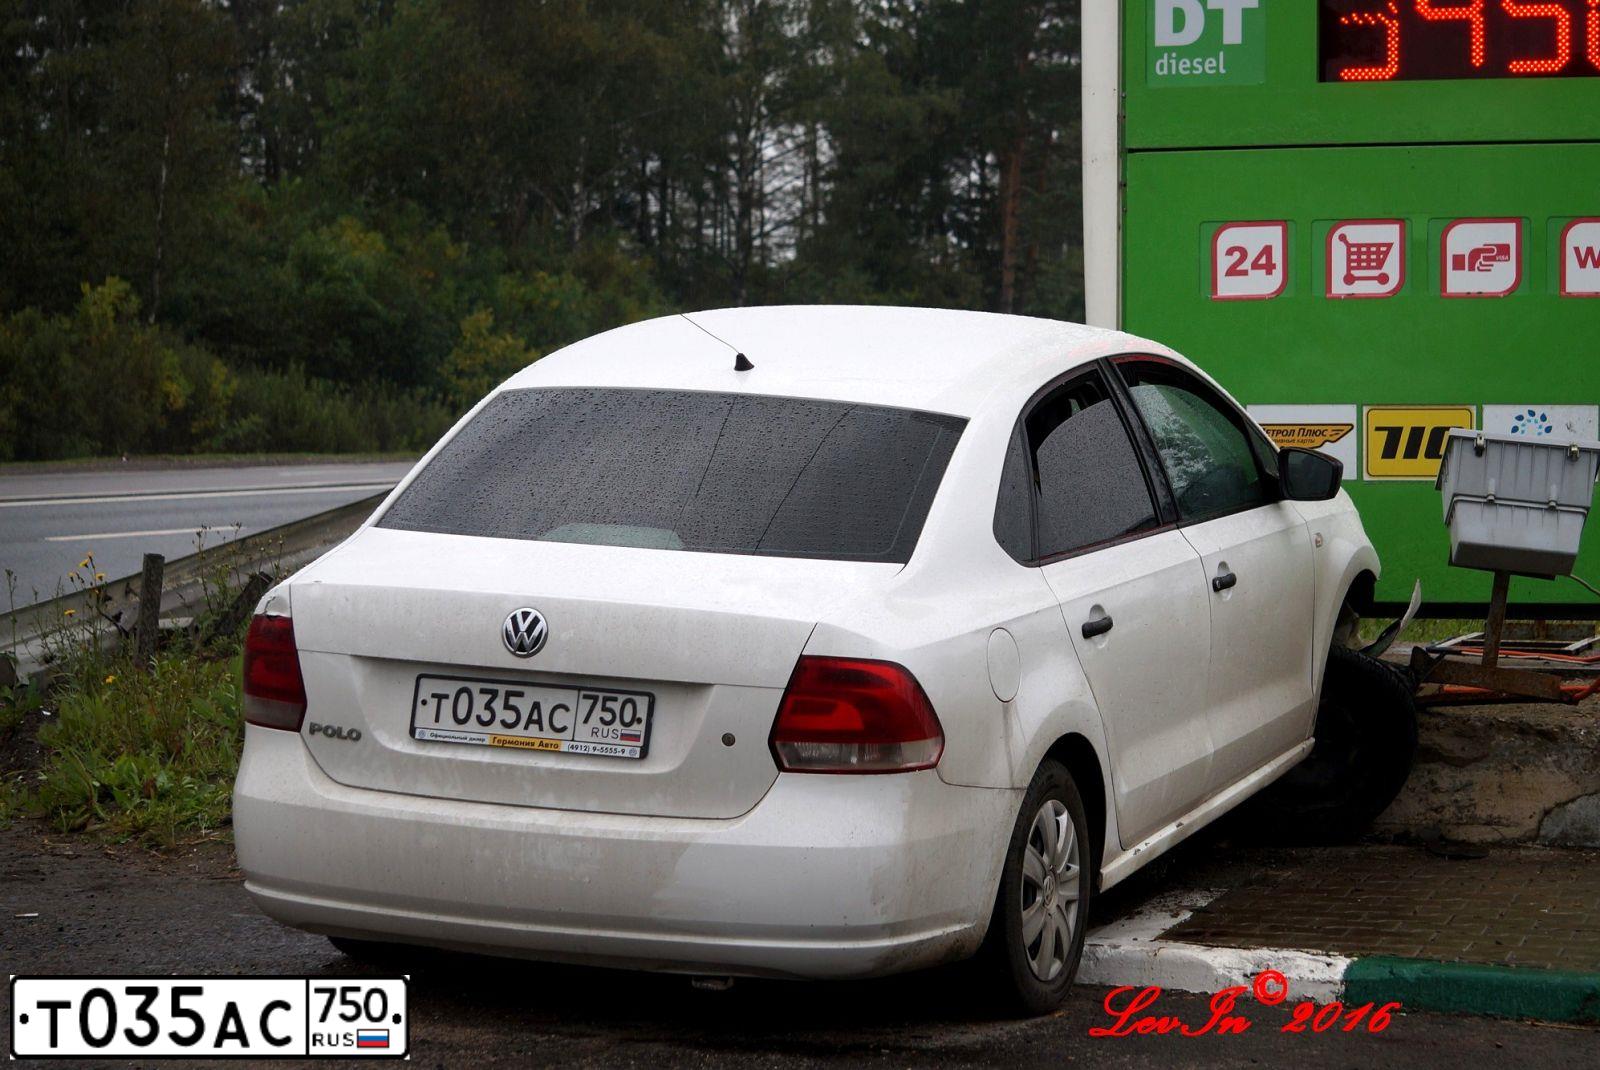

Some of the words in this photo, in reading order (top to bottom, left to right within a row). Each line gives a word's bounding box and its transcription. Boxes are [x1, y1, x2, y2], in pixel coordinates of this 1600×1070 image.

[1340, 0, 1600, 79] 345
[1155, 51, 1226, 75] diesel
[1224, 244, 1277, 277] 24
[1263, 428, 1295, 437] ЕТРОЛ
[582, 694, 638, 727] 750
[309, 722, 362, 742] POLO
[591, 728, 619, 739] RUS
[492, 736, 535, 747] Германия
[538, 739, 559, 749] Авто
[568, 743, 590, 752] (4912)
[592, 746, 626, 755] 9-5555-9
